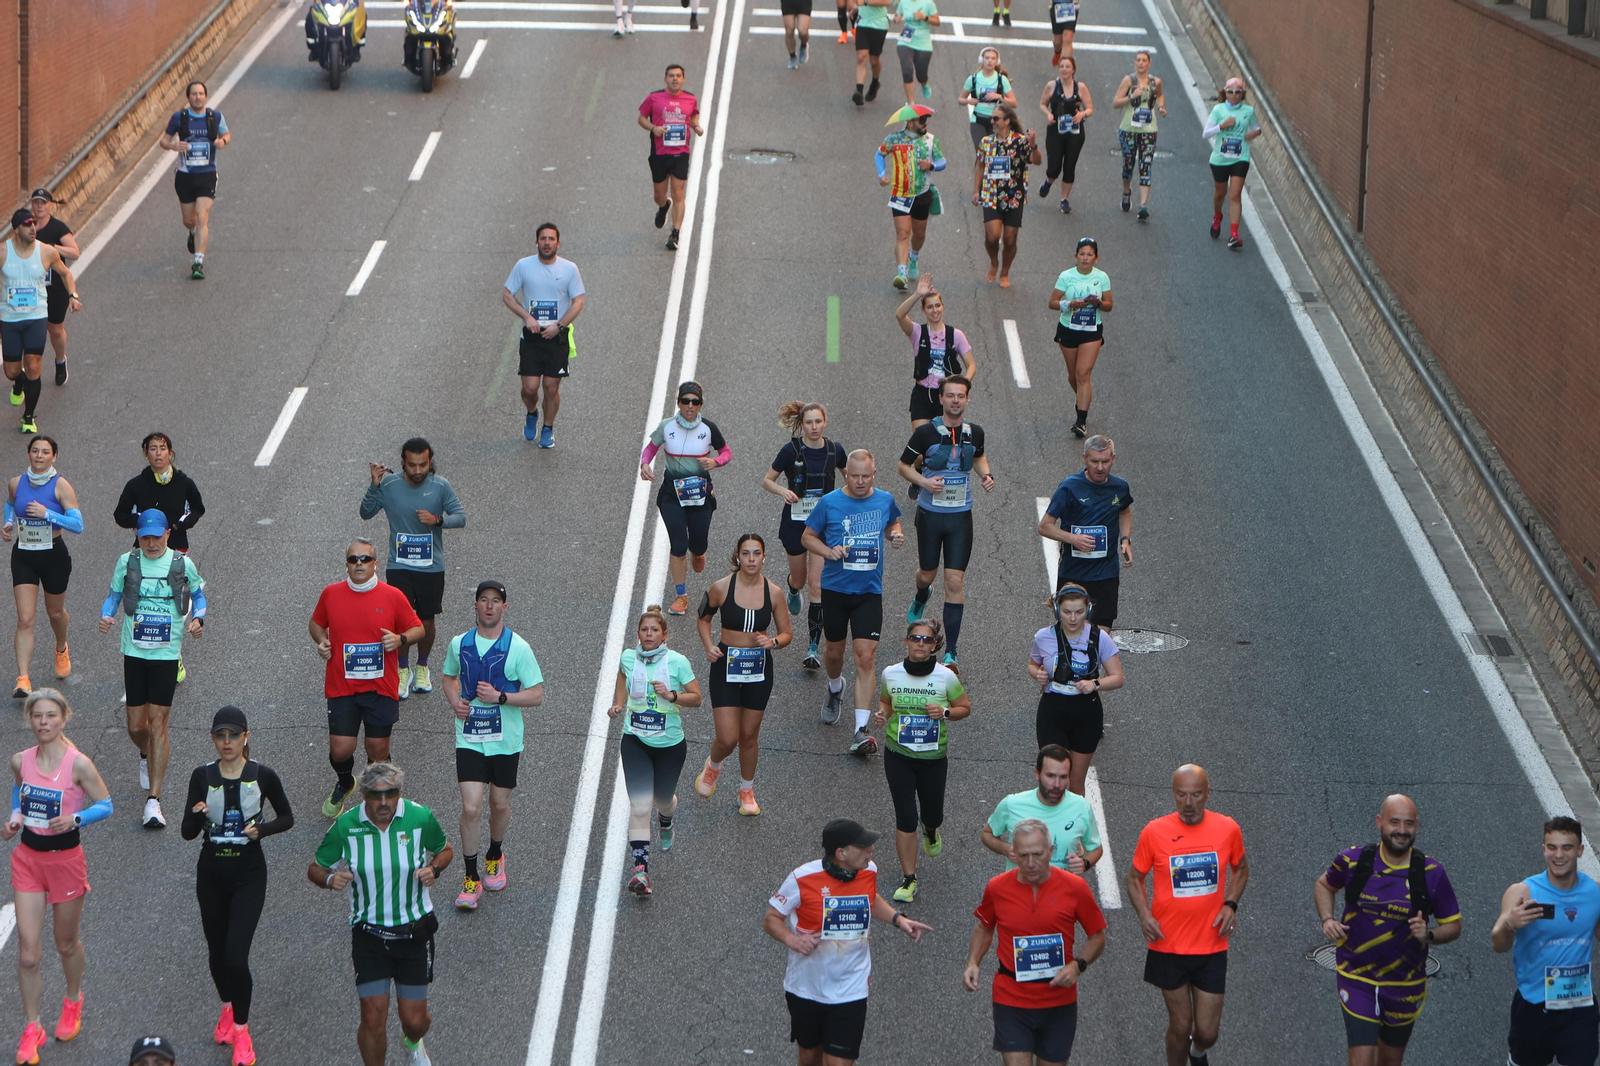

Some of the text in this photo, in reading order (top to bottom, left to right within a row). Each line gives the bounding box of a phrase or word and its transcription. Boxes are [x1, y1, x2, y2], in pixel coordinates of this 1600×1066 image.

[850, 510, 882, 526] PAAVO
[850, 520, 882, 536] NURMI
[896, 695, 928, 705] sano
[32, 789, 57, 798] ZURICH
[30, 802, 48, 811] 12792
[1186, 871, 1205, 879] 12200
[1030, 938, 1057, 946] ZURICH
[1030, 952, 1048, 961] 12492
[1562, 968, 1586, 976] ZURICH
